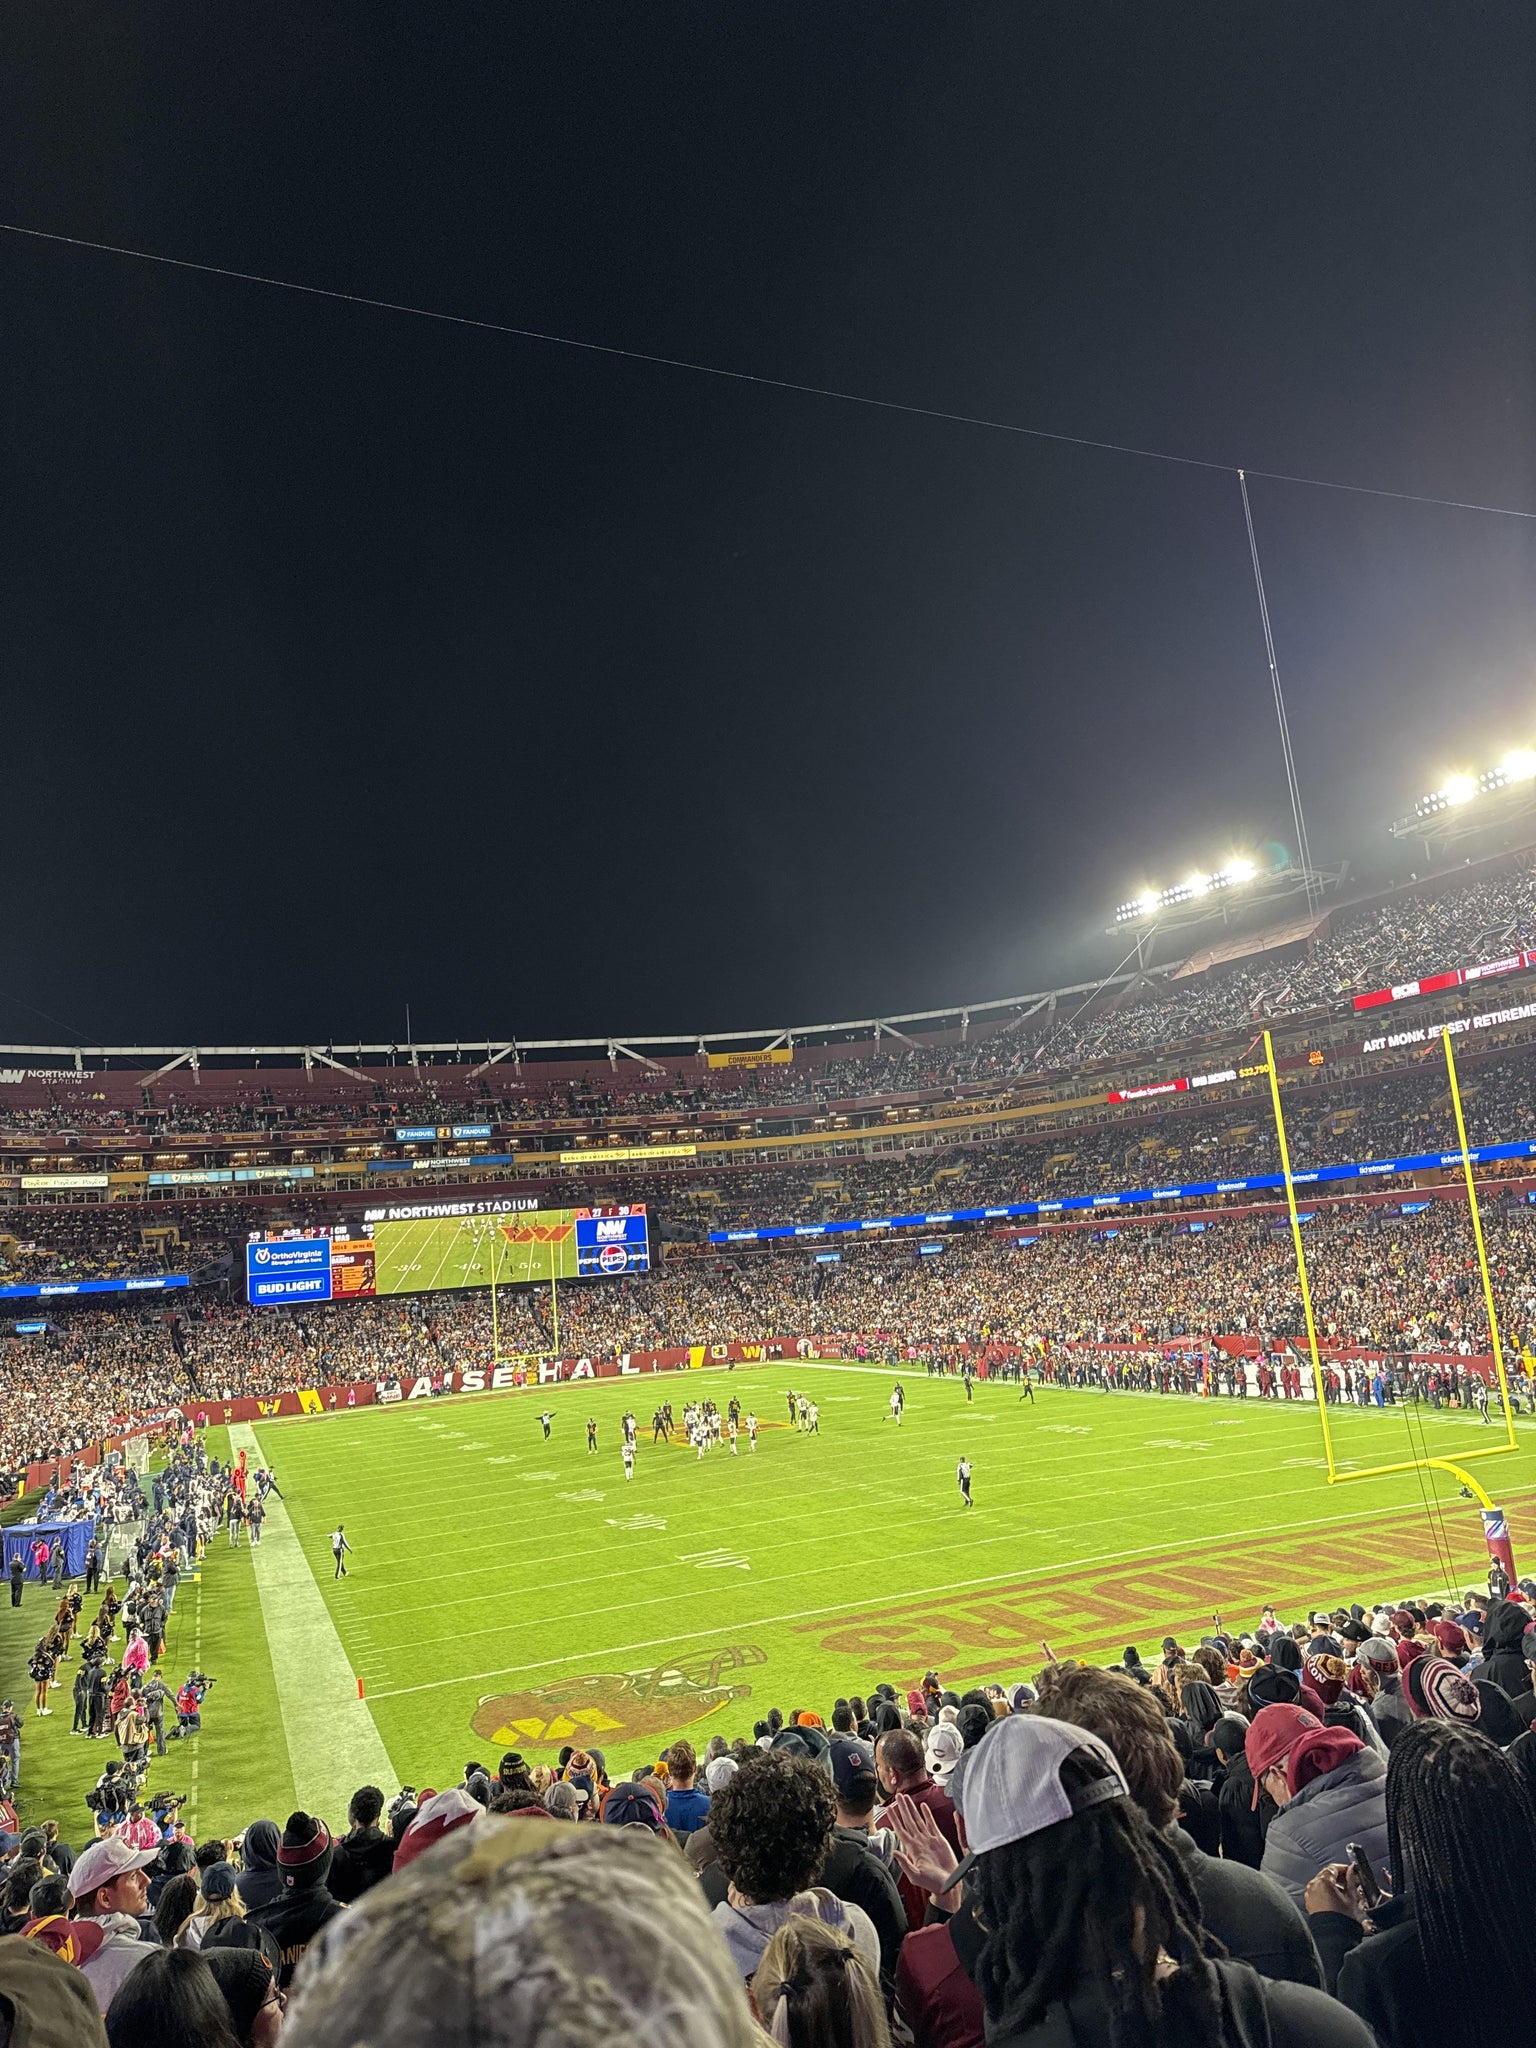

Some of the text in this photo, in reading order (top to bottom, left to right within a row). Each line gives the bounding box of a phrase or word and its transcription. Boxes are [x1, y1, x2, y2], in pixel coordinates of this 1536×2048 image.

[1363, 1038, 1387, 1052] ART
[1388, 1029, 1425, 1047] MONK
[728, 1055, 772, 1064] COMMANDERS
[27, 1070, 95, 1079] NORTHWEST
[406, 1130, 436, 1138] FANDUEL
[462, 1127, 490, 1136] FANDUEL
[430, 1157, 471, 1167] NORTHWEST
[1440, 1152, 1480, 1164] ticketmster
[1359, 1163, 1395, 1174] ticketmaster
[1217, 1182, 1248, 1191] ticketmaster
[389, 1203, 476, 1219] NORTHWEST
[477, 1199, 538, 1213] STADIUM
[271, 1250, 322, 1260] OrthoVirginia
[518, 1262, 541, 1270] 50
[126, 1279, 166, 1289] ticketmaster
[258, 1280, 322, 1294] BUD LIGHT
[40, 1285, 80, 1294] ticketmaster
[539, 1354, 640, 1384] HAL
